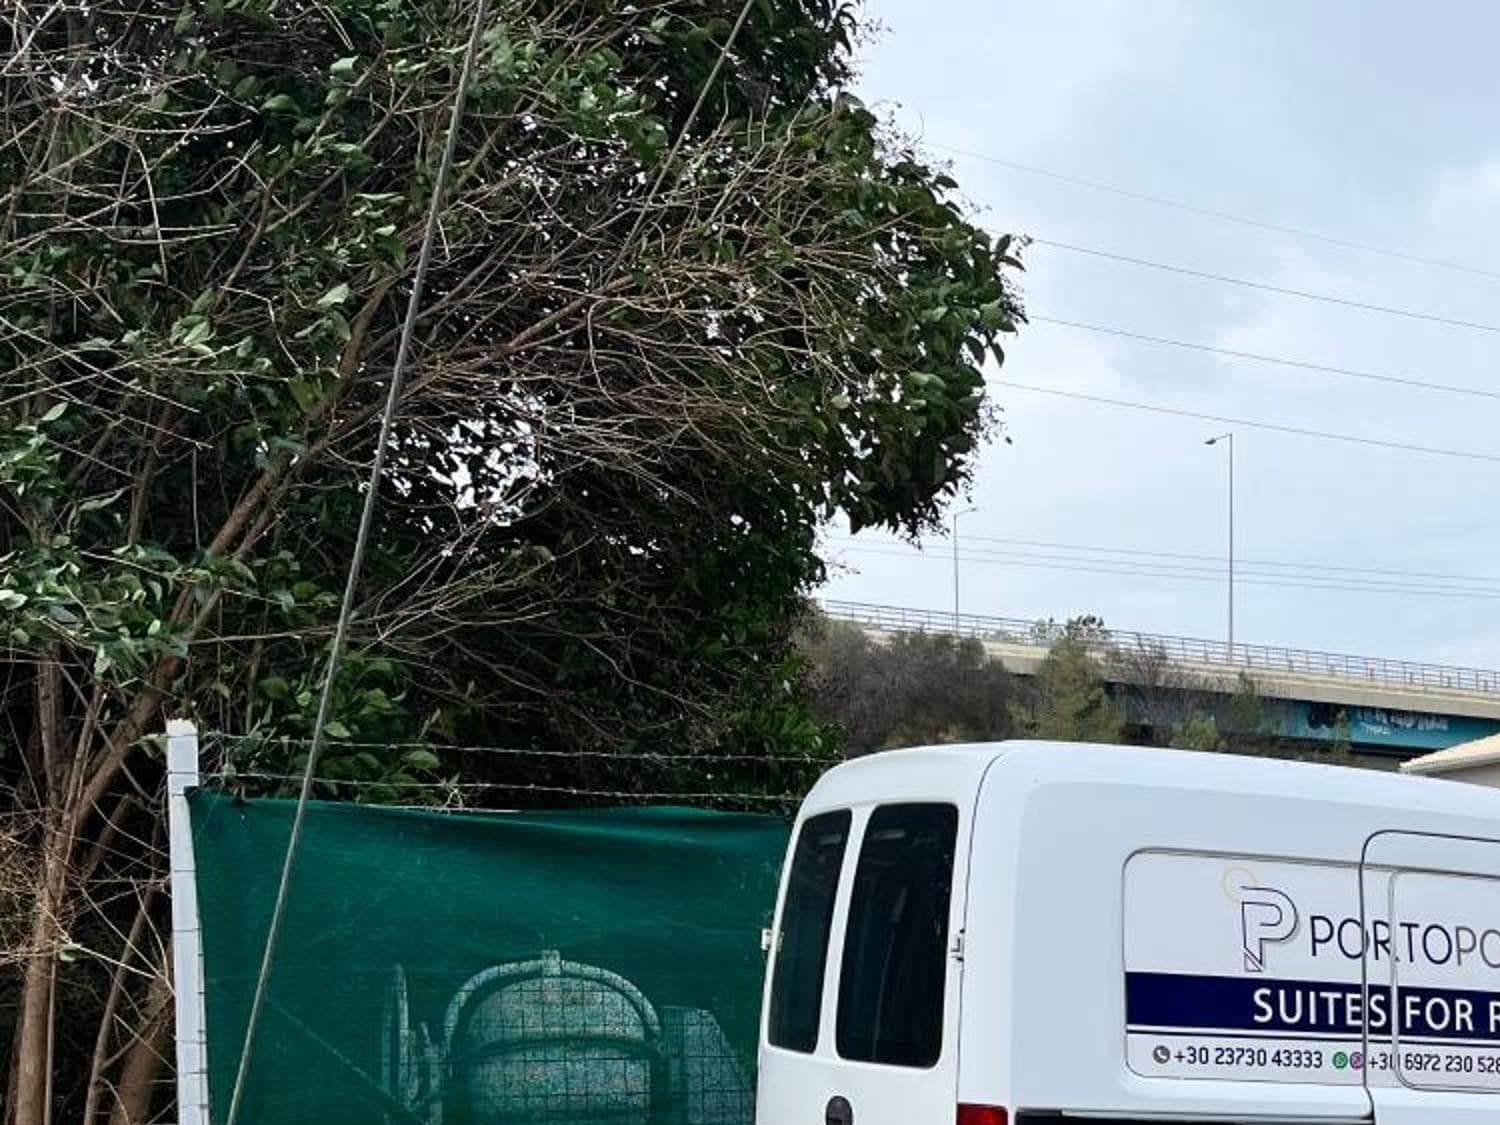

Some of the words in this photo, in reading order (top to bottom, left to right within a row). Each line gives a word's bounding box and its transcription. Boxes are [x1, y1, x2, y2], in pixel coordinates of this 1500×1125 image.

[1252, 987, 1387, 1028] SUITES
[1404, 995, 1474, 1032] FOR
[1173, 1046, 1209, 1065] +30
[1214, 1047, 1268, 1067] 23730
[1271, 1050, 1324, 1069] 43333
[1404, 1053, 1441, 1072] 6972
[1445, 1055, 1473, 1073] 230
